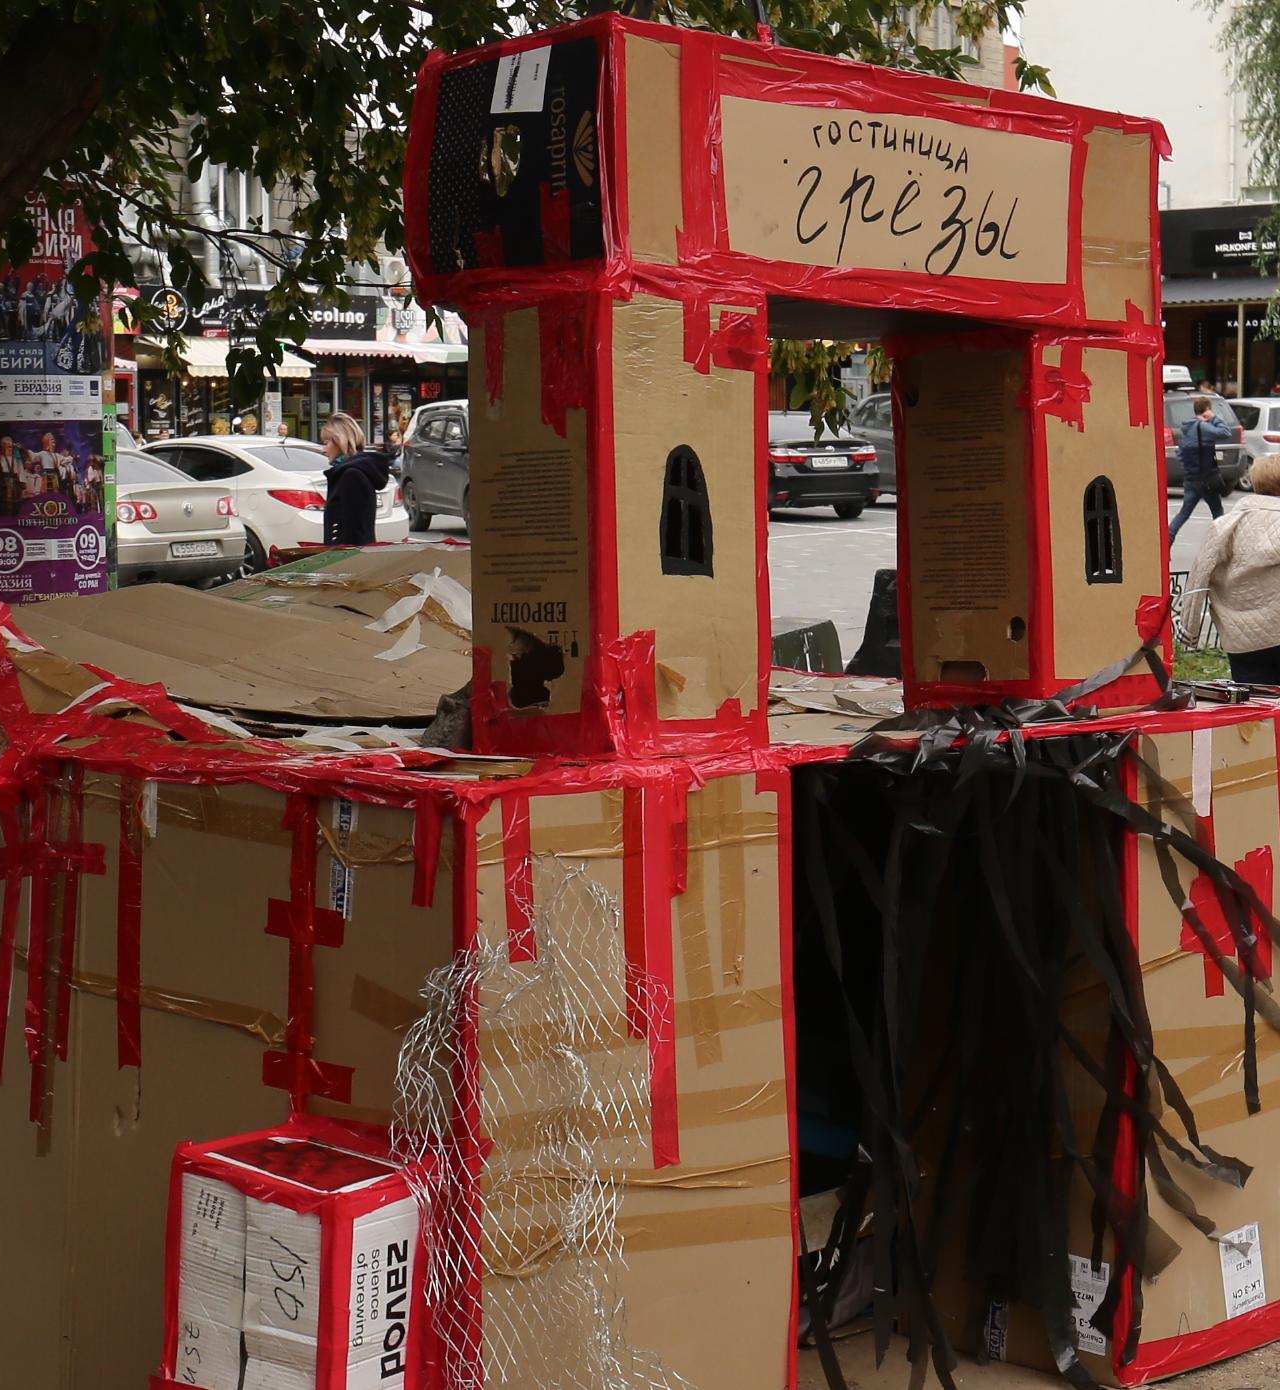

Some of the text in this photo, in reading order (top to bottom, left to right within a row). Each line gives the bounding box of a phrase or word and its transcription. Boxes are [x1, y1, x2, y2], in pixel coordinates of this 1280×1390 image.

[18, 347, 44, 356] сила
[14, 383, 62, 393] ЕВРАЗИЯ
[30, 500, 70, 517] ХОР
[79, 533, 97, 548] 09
[370, 1248, 380, 1321] science
[352, 1252, 367, 1347] of brewing
[380, 1239, 409, 1380] zavod
